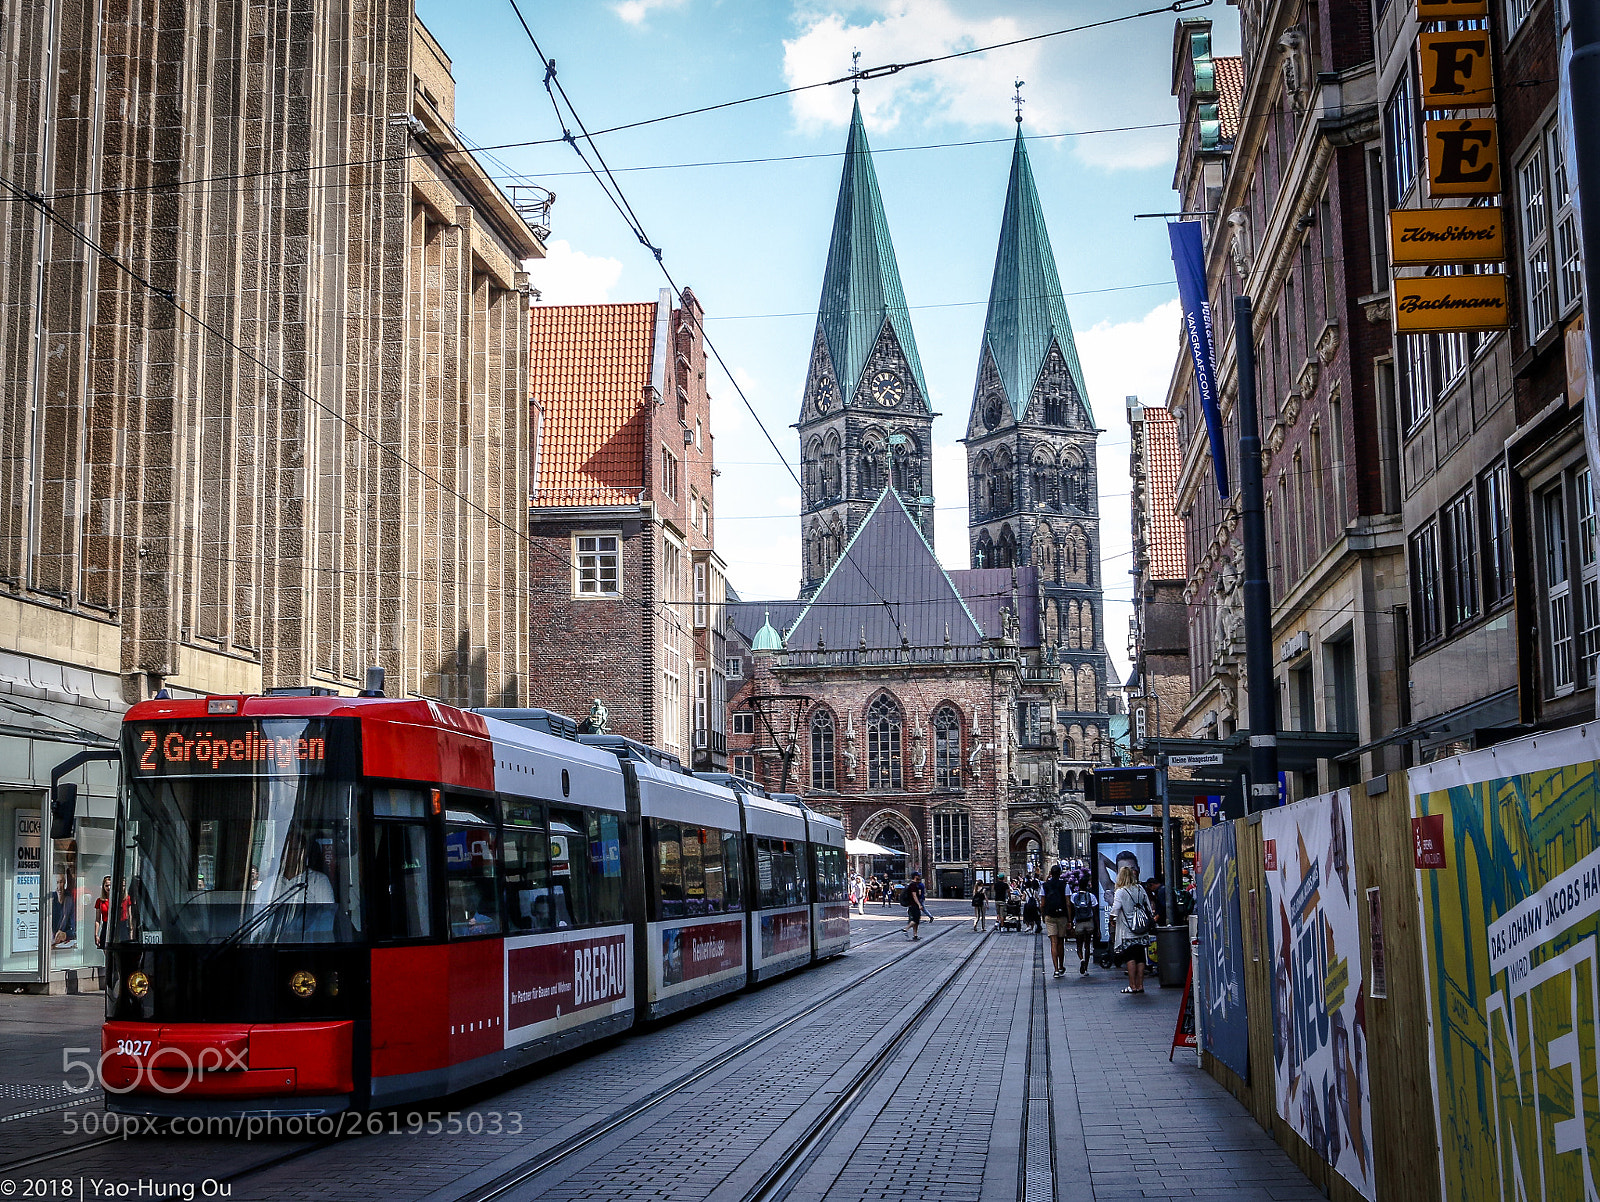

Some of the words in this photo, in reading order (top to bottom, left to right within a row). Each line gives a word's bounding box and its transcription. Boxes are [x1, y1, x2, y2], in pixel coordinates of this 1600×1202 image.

[1400, 224, 1496, 244] Konditorei
[1399, 293, 1505, 314] Bachmann
[1187, 312, 1210, 400] VANGRAAF.COM
[140, 730, 157, 770] 2
[163, 731, 325, 769] Gröpelingen
[1196, 802, 1218, 818] P&C
[1491, 929, 1506, 961] DAS
[1508, 905, 1542, 950] JOHANN
[1545, 878, 1580, 927] JACOBS
[1583, 864, 1600, 901] HA
[144, 934, 160, 944] 5010
[574, 942, 625, 1006] BREBAU
[1509, 956, 1528, 984] WIRD
[517, 989, 532, 1003] Partner
[538, 985, 550, 998] Bauen
[550, 983, 558, 996] und
[1291, 907, 1329, 1068] NEU
[116, 1039, 152, 1057] 3027
[1487, 943, 1600, 1202] NE
